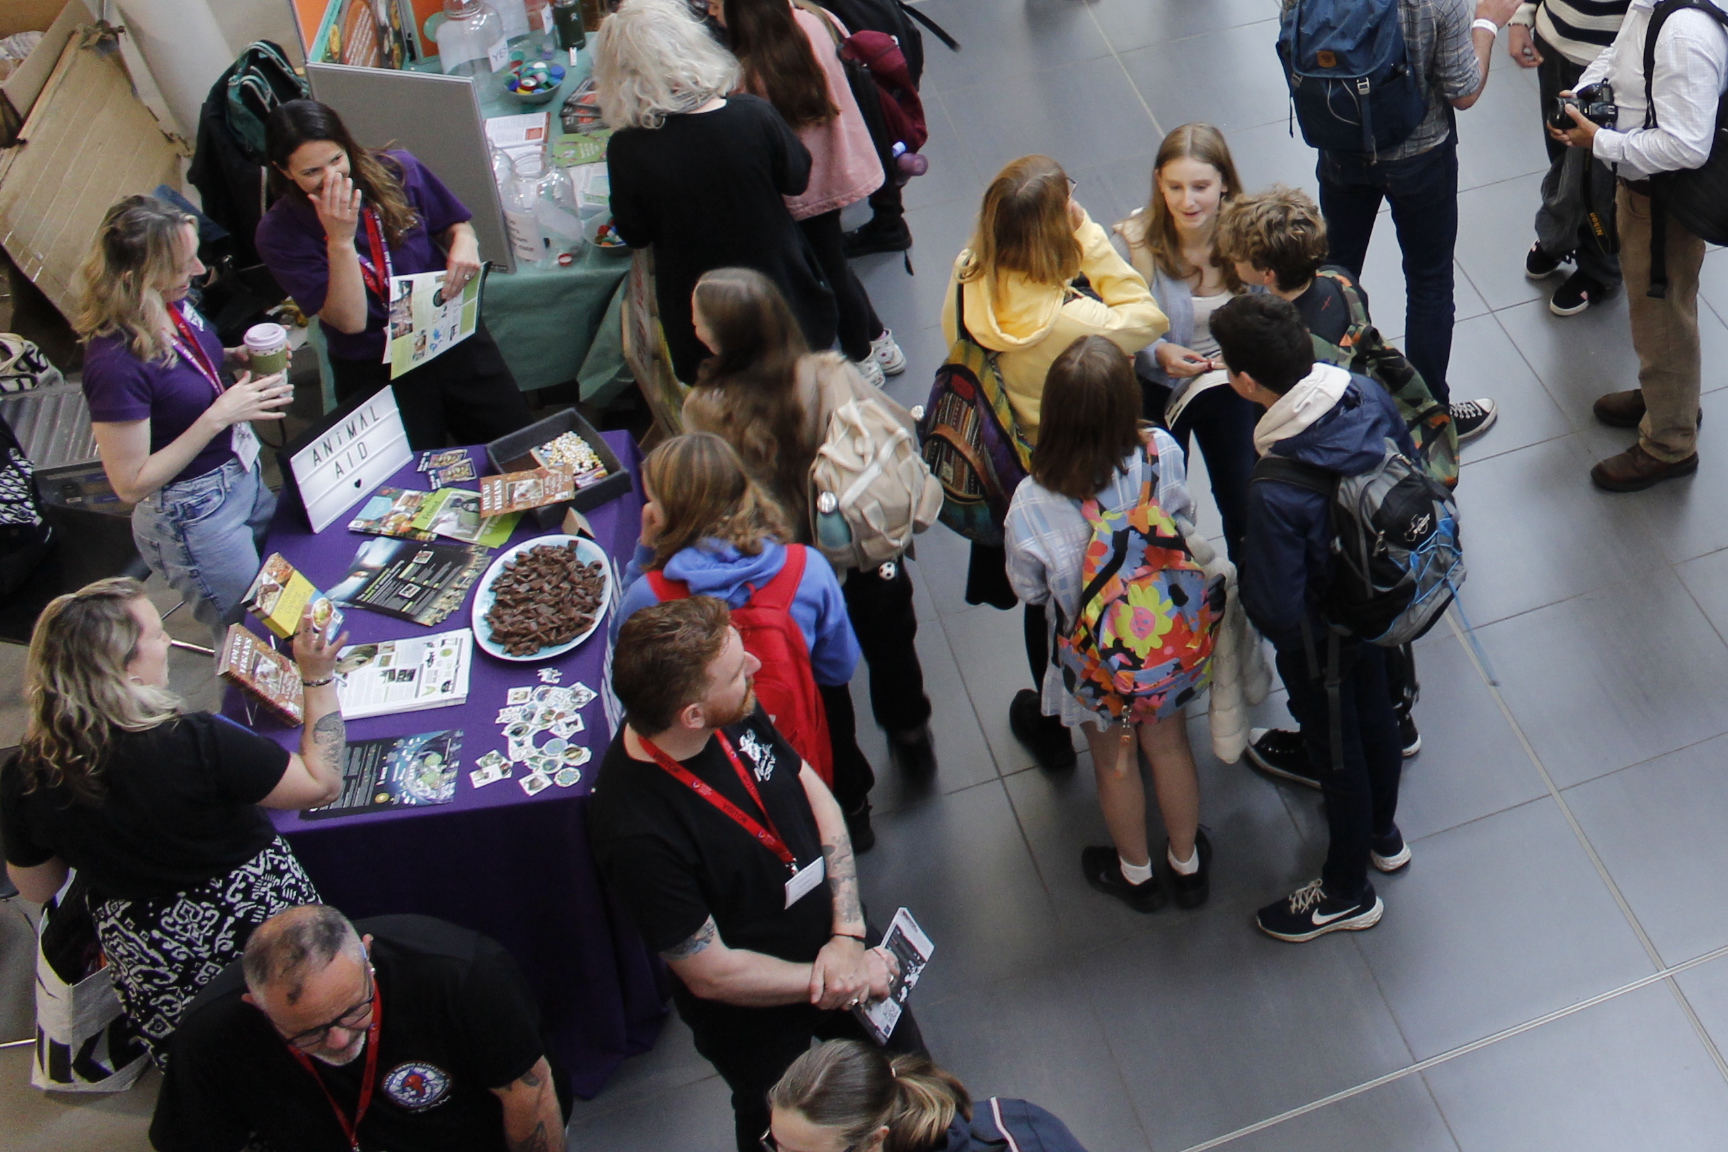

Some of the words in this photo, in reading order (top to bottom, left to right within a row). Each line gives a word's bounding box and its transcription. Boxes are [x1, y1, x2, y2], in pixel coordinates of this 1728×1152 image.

[334, 441, 369, 480] AID
[482, 483, 492, 511] YOUNG
[493, 479, 504, 511] VEGANS
[653, 750, 681, 775] VISITOR
[722, 801, 749, 825] VISITOR
